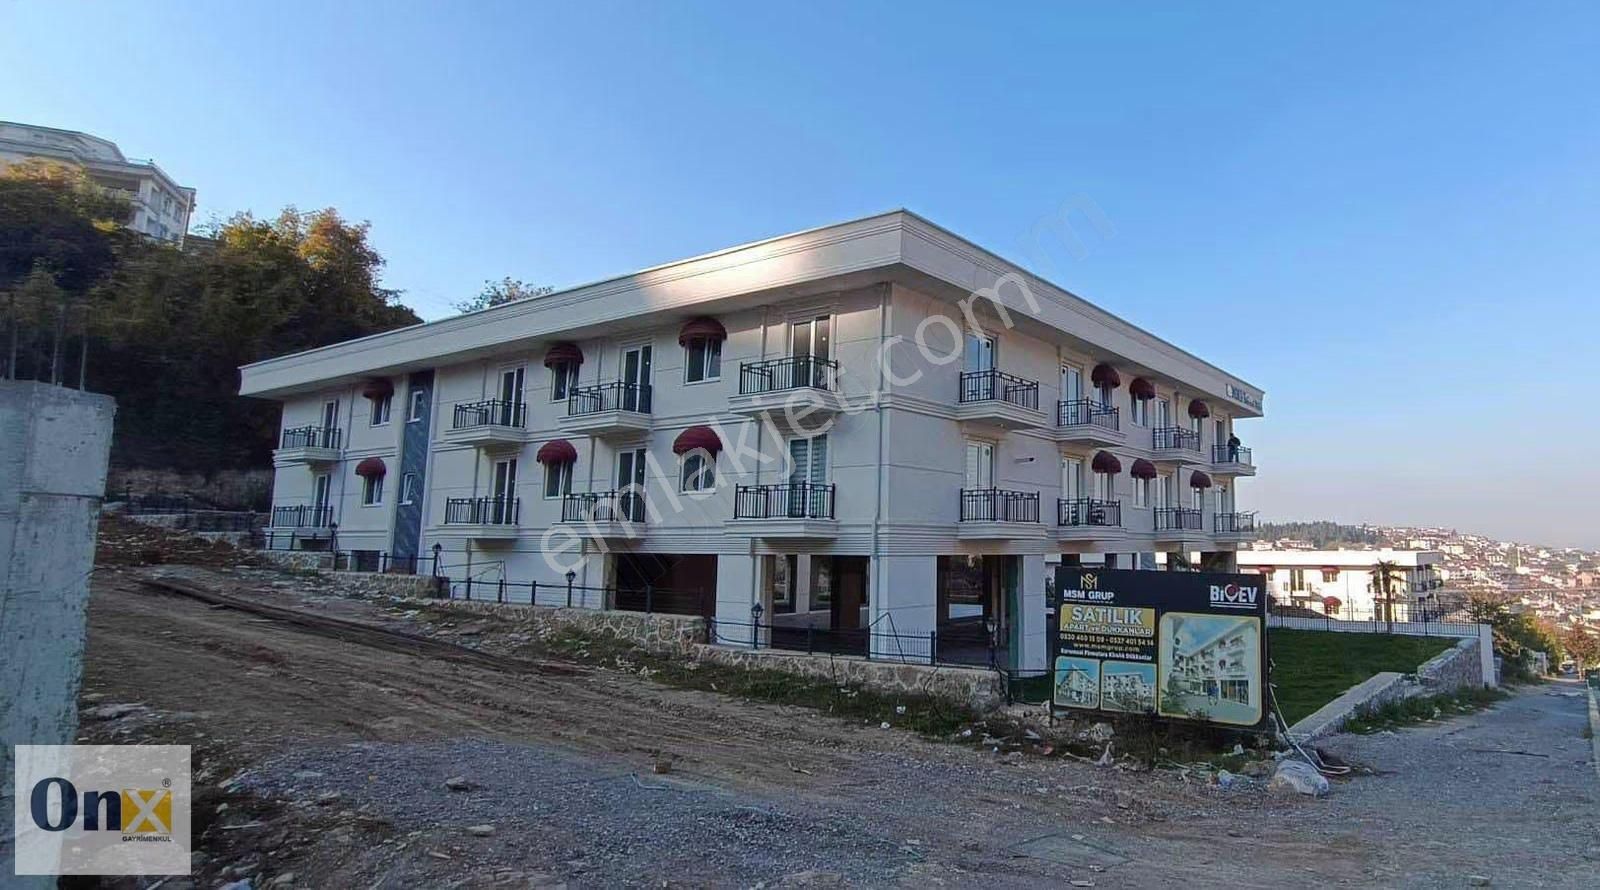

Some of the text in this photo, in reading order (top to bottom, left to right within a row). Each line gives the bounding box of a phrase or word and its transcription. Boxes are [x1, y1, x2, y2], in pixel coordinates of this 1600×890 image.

[1063, 589, 1086, 599] MSM
[1088, 590, 1115, 601] GRUP
[1072, 606, 1143, 625] SATILIK
